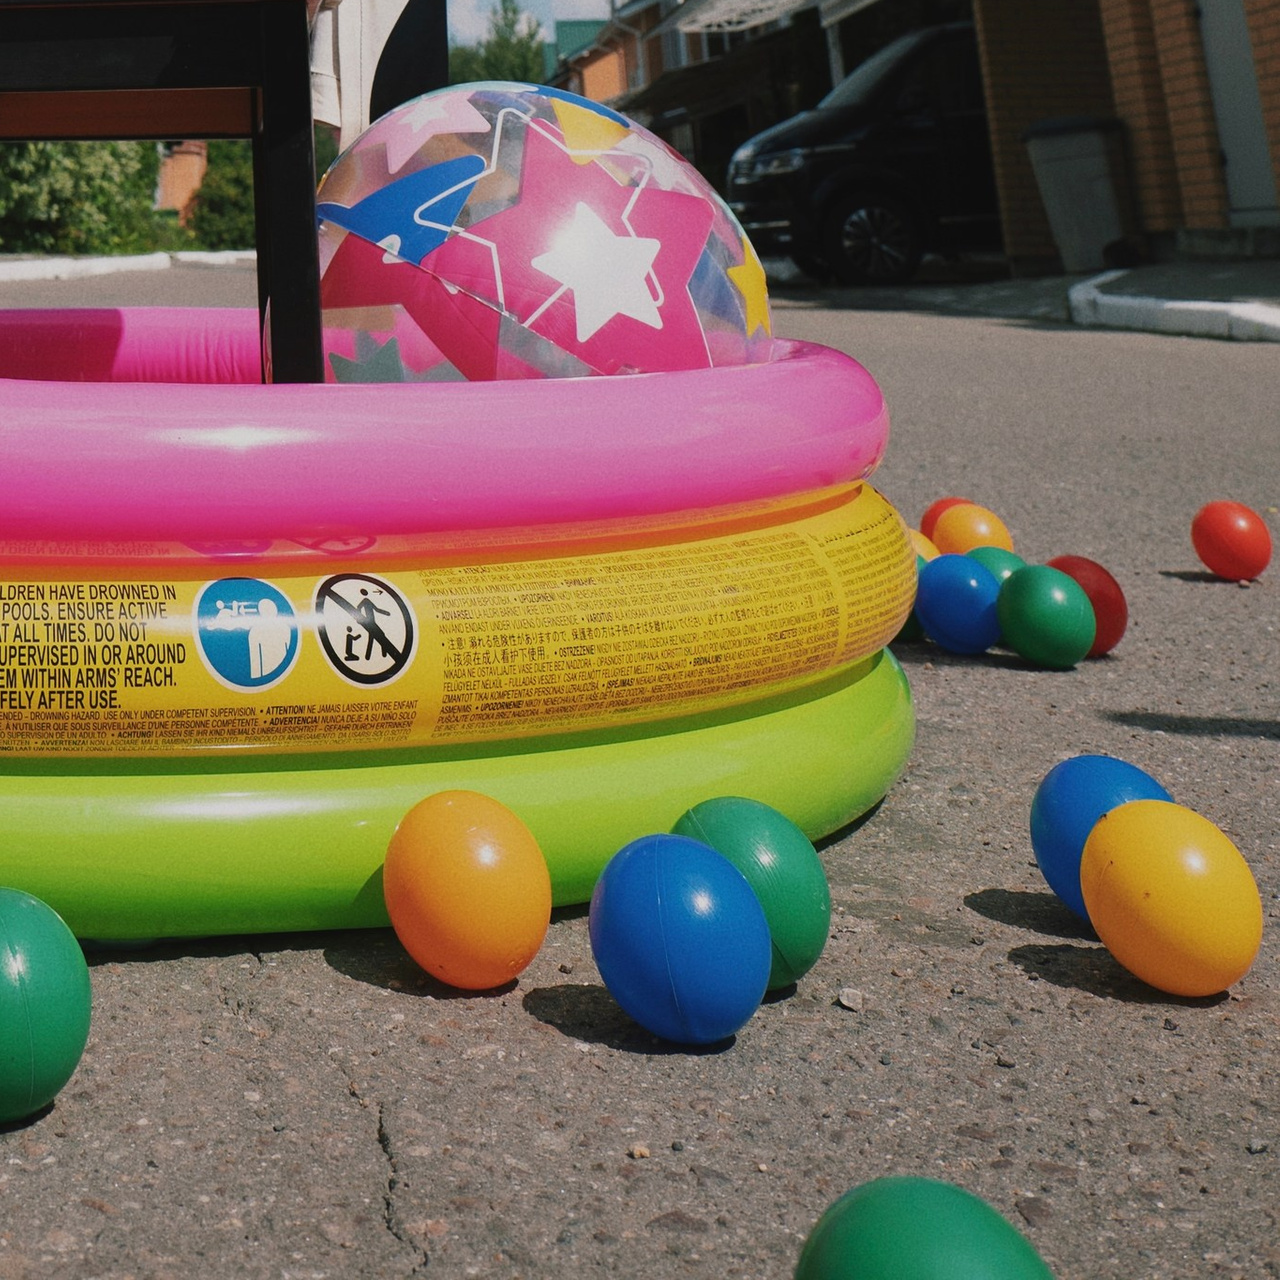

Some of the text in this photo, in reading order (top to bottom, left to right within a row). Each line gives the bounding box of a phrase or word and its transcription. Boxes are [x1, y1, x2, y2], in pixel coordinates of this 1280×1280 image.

[49, 585, 86, 600] HAVE
[89, 584, 160, 600] DROWNED
[162, 584, 177, 600] IN
[2, 602, 53, 621] POOLS.
[58, 602, 114, 620] ENSURE
[118, 602, 167, 620] ACTIVE
[12, 623, 40, 642] ALL
[44, 623, 90, 642] TIMES.
[94, 622, 115, 642] DO
[119, 622, 147, 642] NOT
[83, 645, 97, 666] IN
[101, 645, 122, 666] OR
[125, 643, 186, 665] AROUND
[21, 668, 71, 688] WITHIN
[124, 666, 177, 687] REACH.
[37, 690, 85, 709] AFTER
[89, 690, 121, 709] USE.
[30, 711, 69, 720] DROWNING
[103, 711, 118, 720] USE
[120, 710, 139, 720] ONLY
[140, 710, 165, 719] UNDER
[165, 709, 209, 719] COMPETENT
[266, 705, 306, 715] ATTENTION!
[306, 704, 316, 714] NE
[317, 703, 341, 714] JAMAIS
[342, 702, 370, 713] LAISSER
[370, 701, 392, 712] VOTRE
[393, 700, 418, 710] ENFANT
[53, 722, 68, 731] QUE
[70, 722, 91, 731] SOUS
[92, 720, 147, 731] SURVEILLANCE
[170, 720, 211, 729] PERSONNE
[270, 715, 320, 726] ADVERTENCIA!
[321, 714, 345, 724] NUNCA
[346, 713, 363, 723] DEJE
[364, 713, 370, 722] A
[370, 713, 381, 721] SU
[398, 710, 417, 720] SOLO
